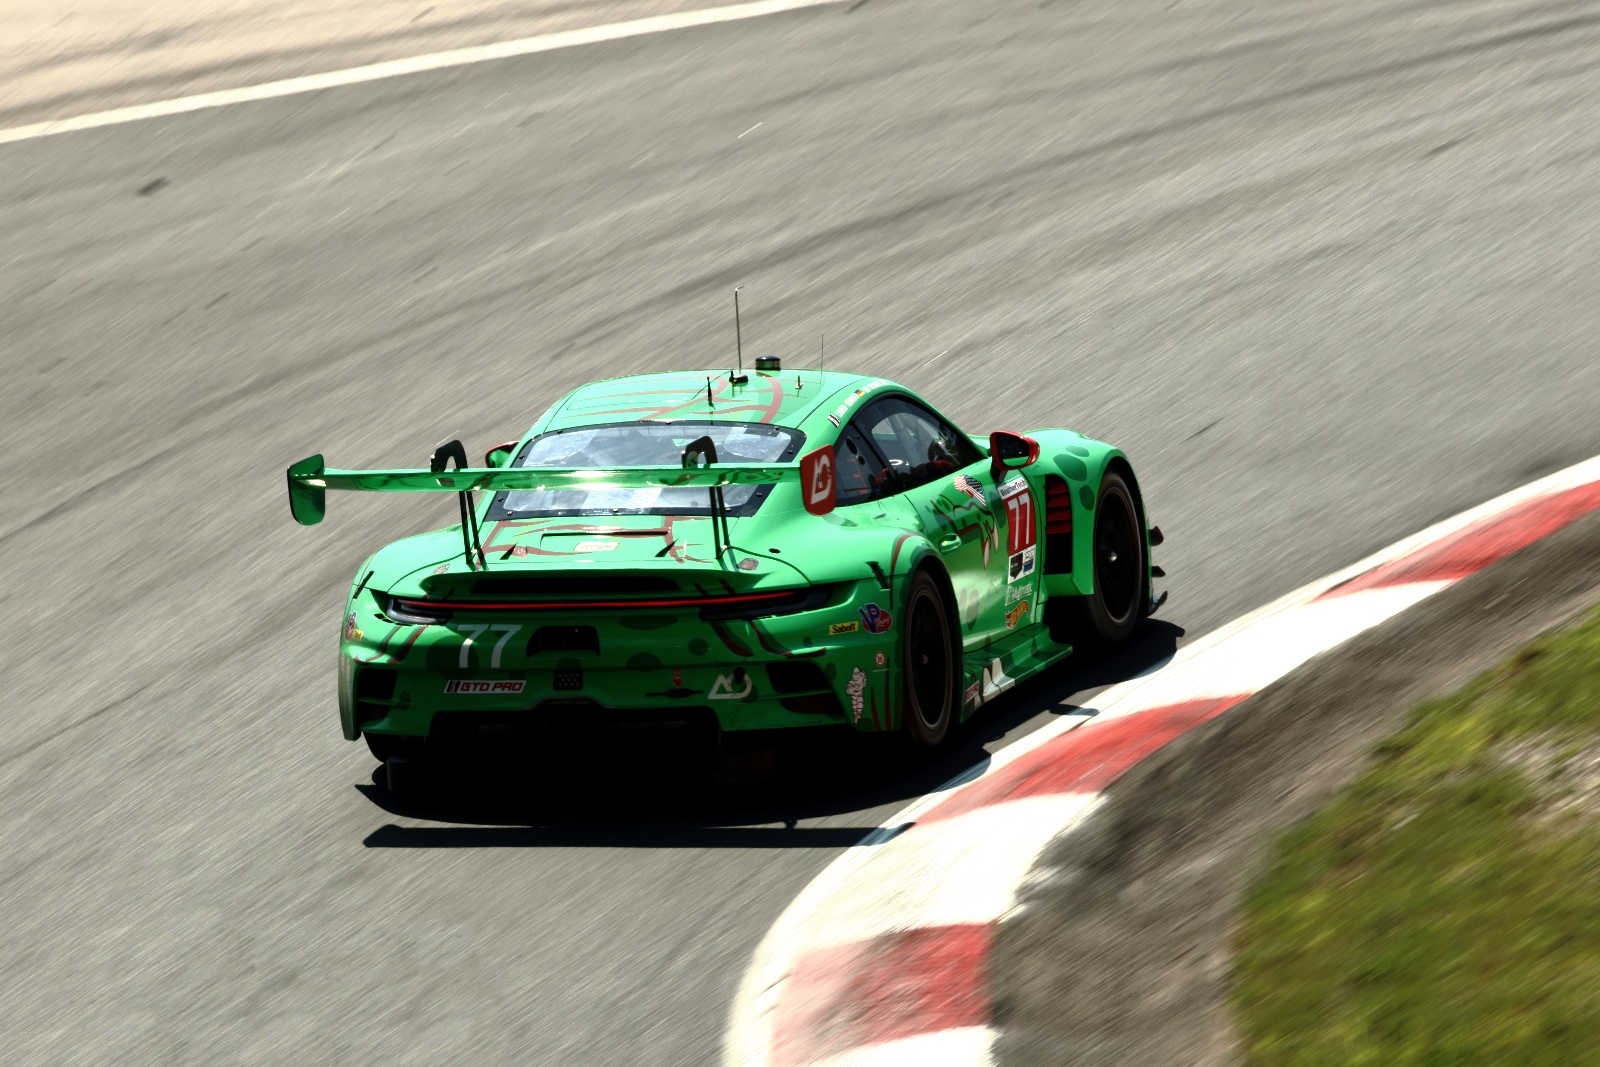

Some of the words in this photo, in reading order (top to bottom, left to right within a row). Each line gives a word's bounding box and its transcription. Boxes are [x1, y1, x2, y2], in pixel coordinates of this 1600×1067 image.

[1007, 491, 1031, 551] 77
[832, 622, 856, 634] Sabelt
[456, 623, 522, 669] 77
[460, 681, 491, 692] GTD
[491, 681, 524, 692] PRO
